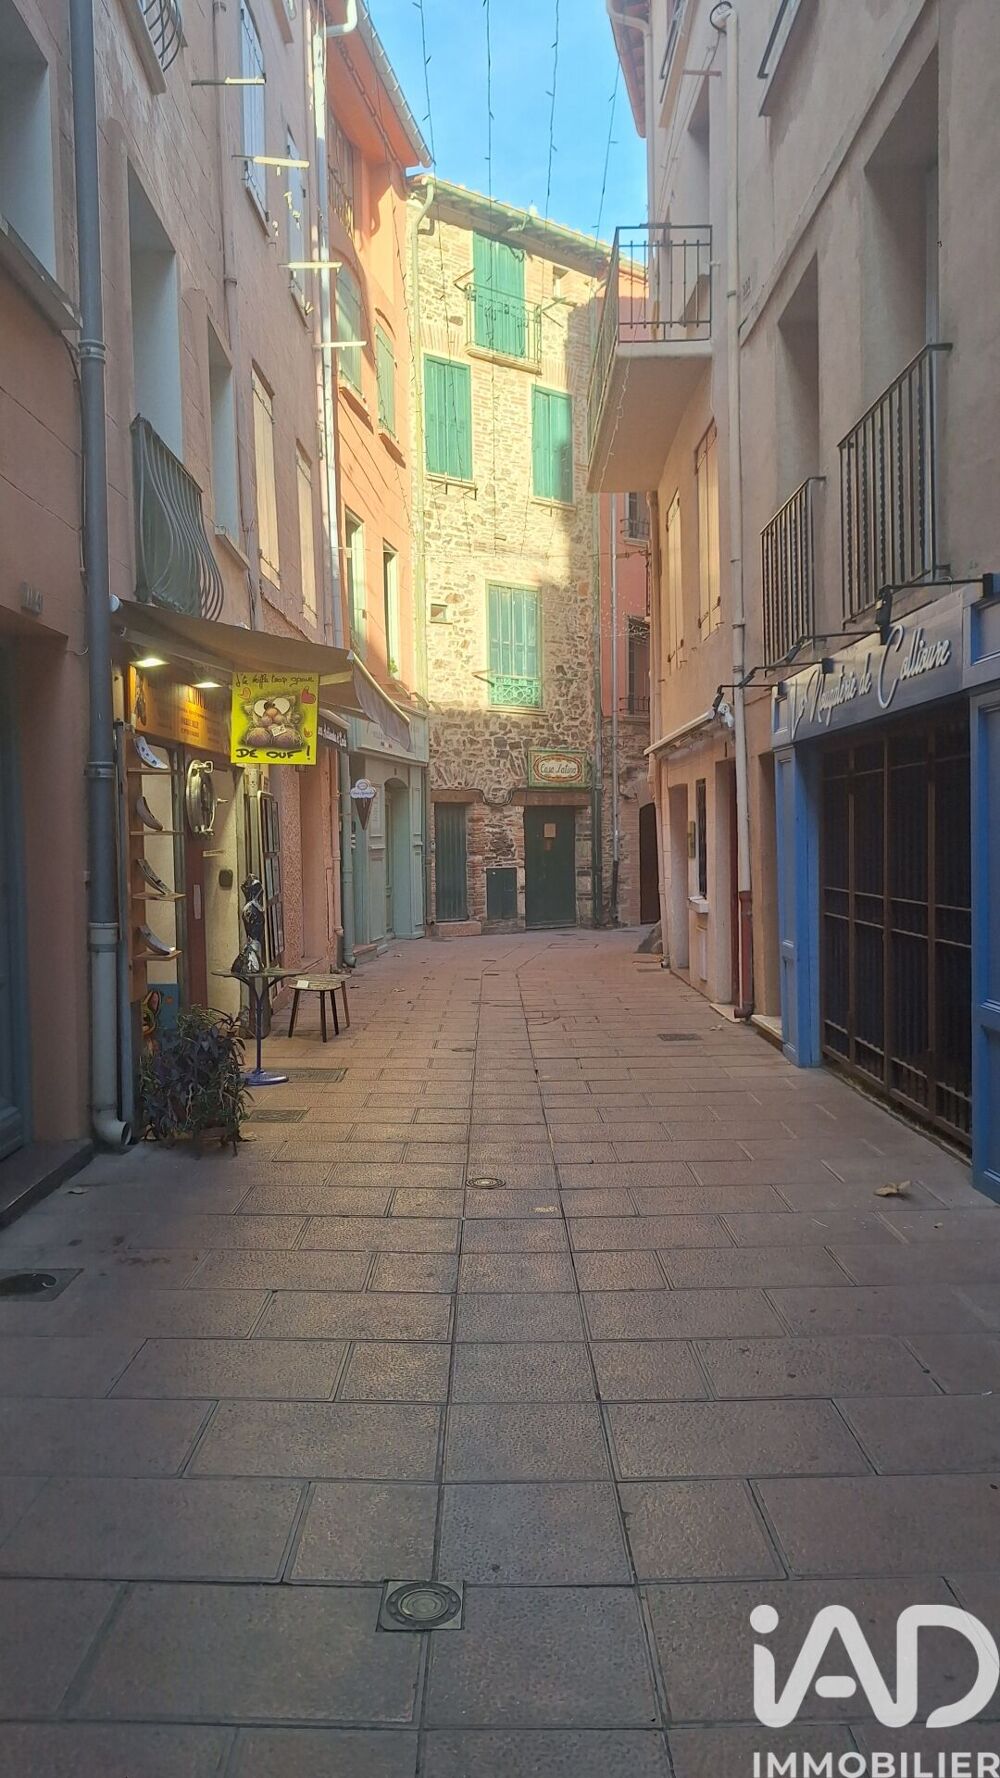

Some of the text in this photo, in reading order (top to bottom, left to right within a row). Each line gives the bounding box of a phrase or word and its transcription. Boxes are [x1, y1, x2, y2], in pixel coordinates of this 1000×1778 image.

[859, 652, 872, 696] de
[877, 624, 952, 709] Collioure
[235, 748, 258, 758] DE
[266, 749, 302, 759] OUF
